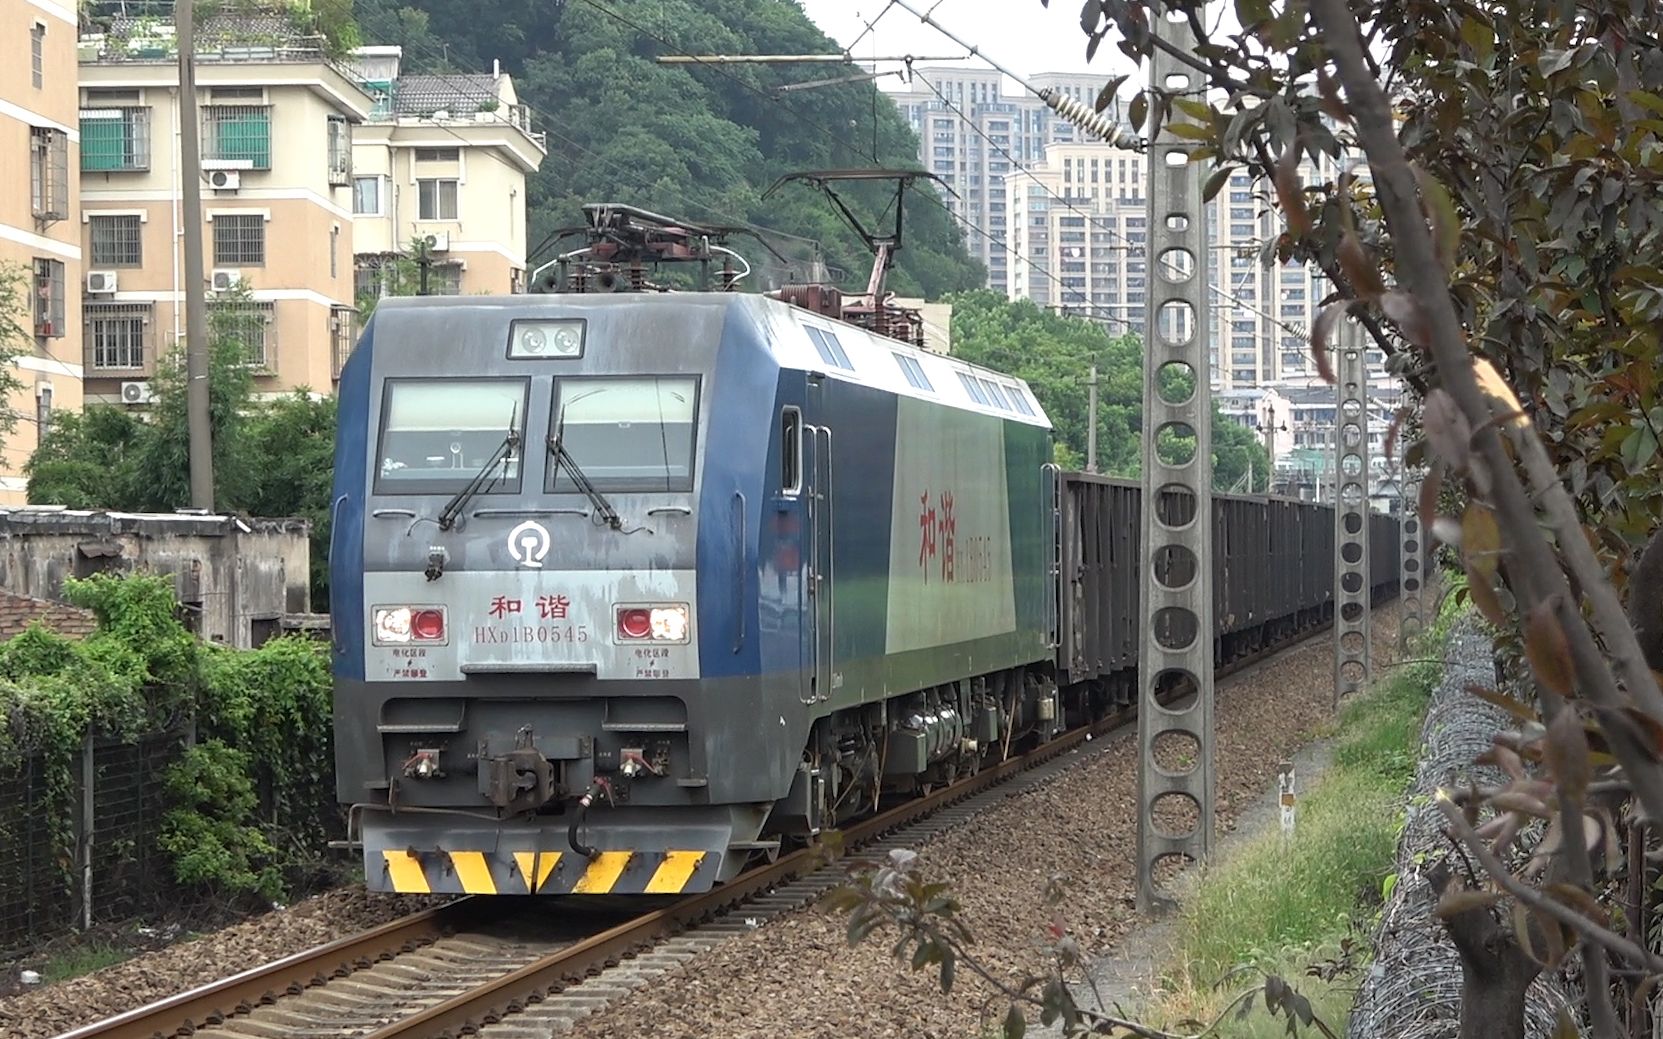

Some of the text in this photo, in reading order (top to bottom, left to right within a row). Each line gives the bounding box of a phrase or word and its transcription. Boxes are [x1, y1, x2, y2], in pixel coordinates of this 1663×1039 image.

[919, 489, 956, 585] 和谐
[489, 595, 570, 620] 和谐
[475, 625, 588, 644] HXD1B0545
